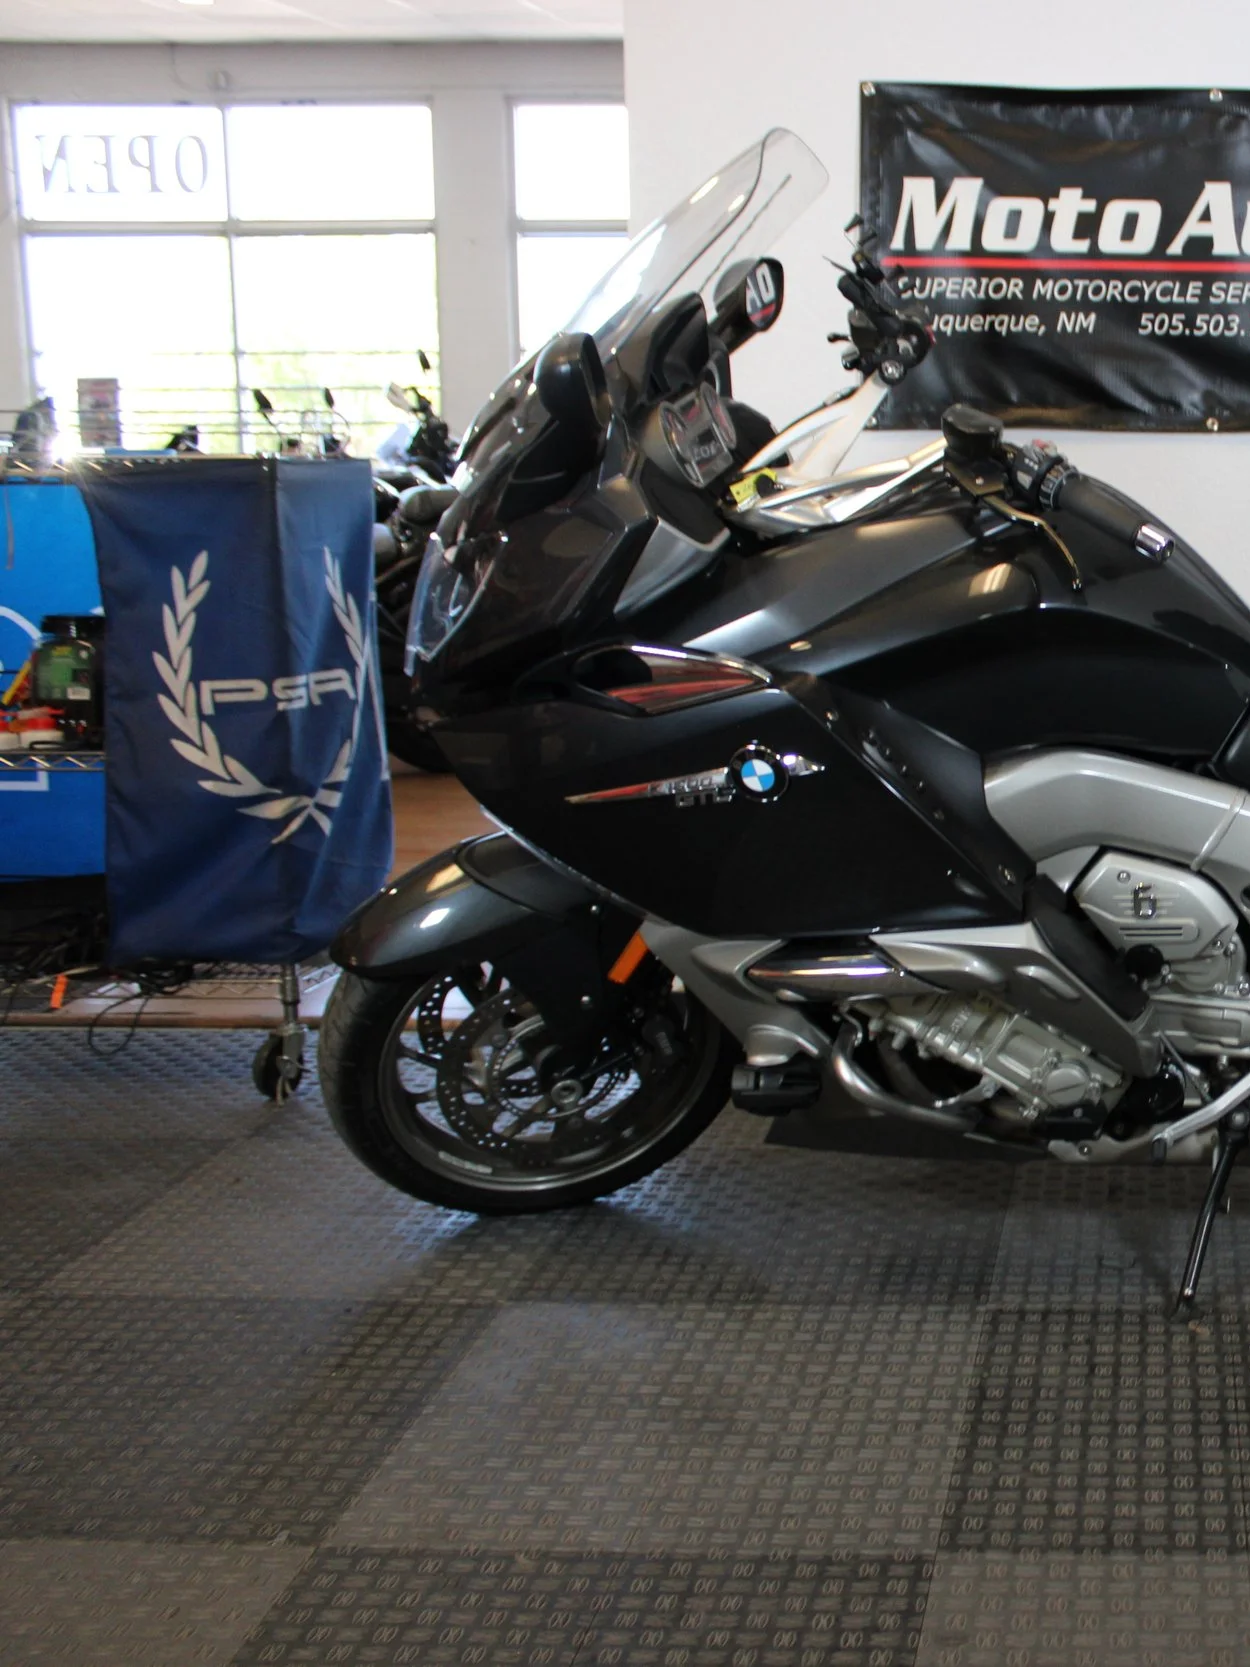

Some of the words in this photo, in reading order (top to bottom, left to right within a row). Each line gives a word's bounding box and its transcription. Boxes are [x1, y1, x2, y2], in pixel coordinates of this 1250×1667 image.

[897, 277, 1024, 300] SUPERIOR
[1032, 278, 1203, 303] MOTORCYCLE
[1056, 312, 1097, 334] NM
[1133, 881, 1157, 920] 6
